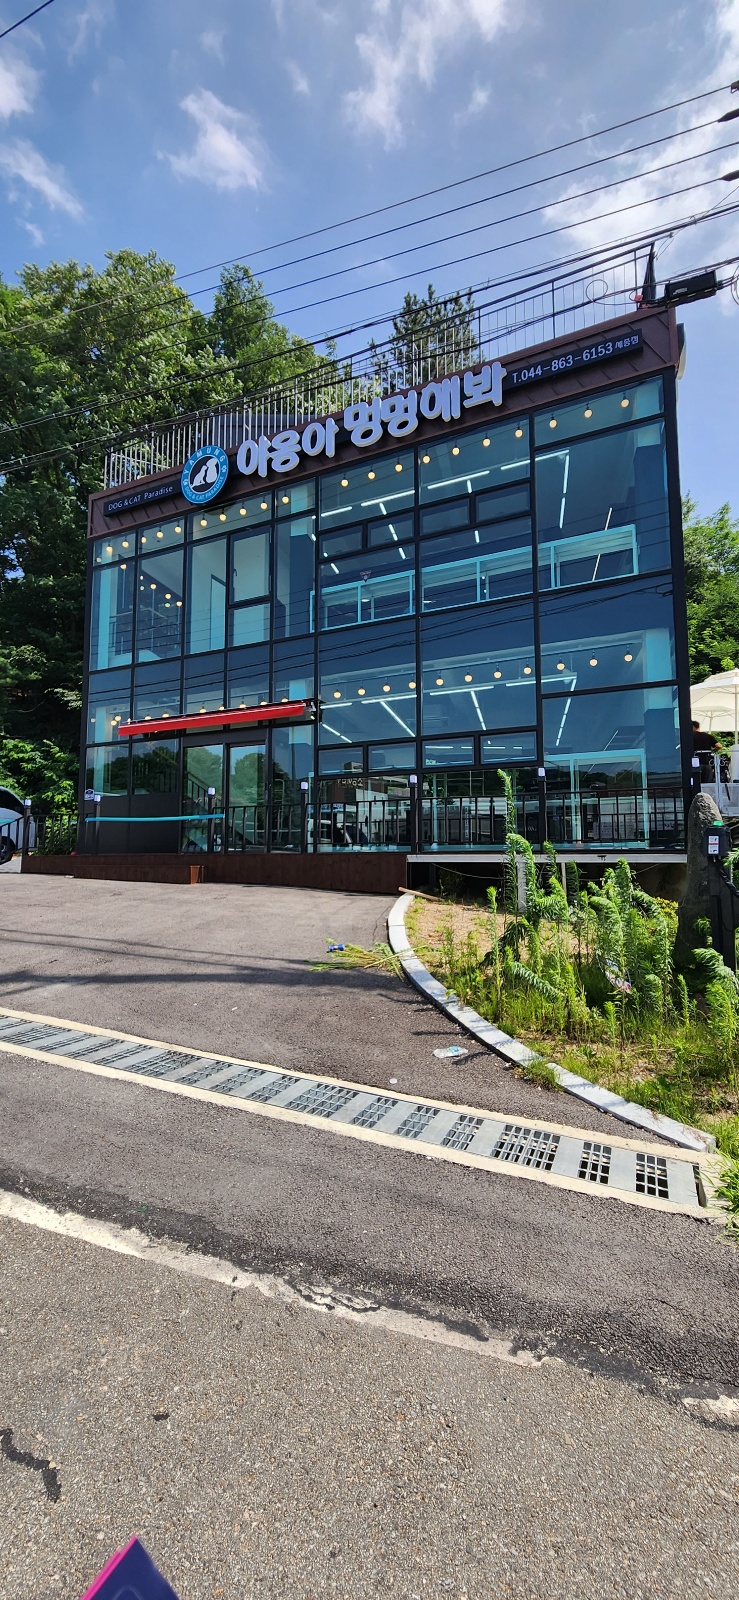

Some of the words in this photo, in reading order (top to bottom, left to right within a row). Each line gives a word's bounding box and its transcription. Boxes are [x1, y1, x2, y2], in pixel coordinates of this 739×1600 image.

[237, 417, 340, 477] 야옹아
[108, 500, 122, 511] DOG
[144, 486, 173, 499] Paradise
